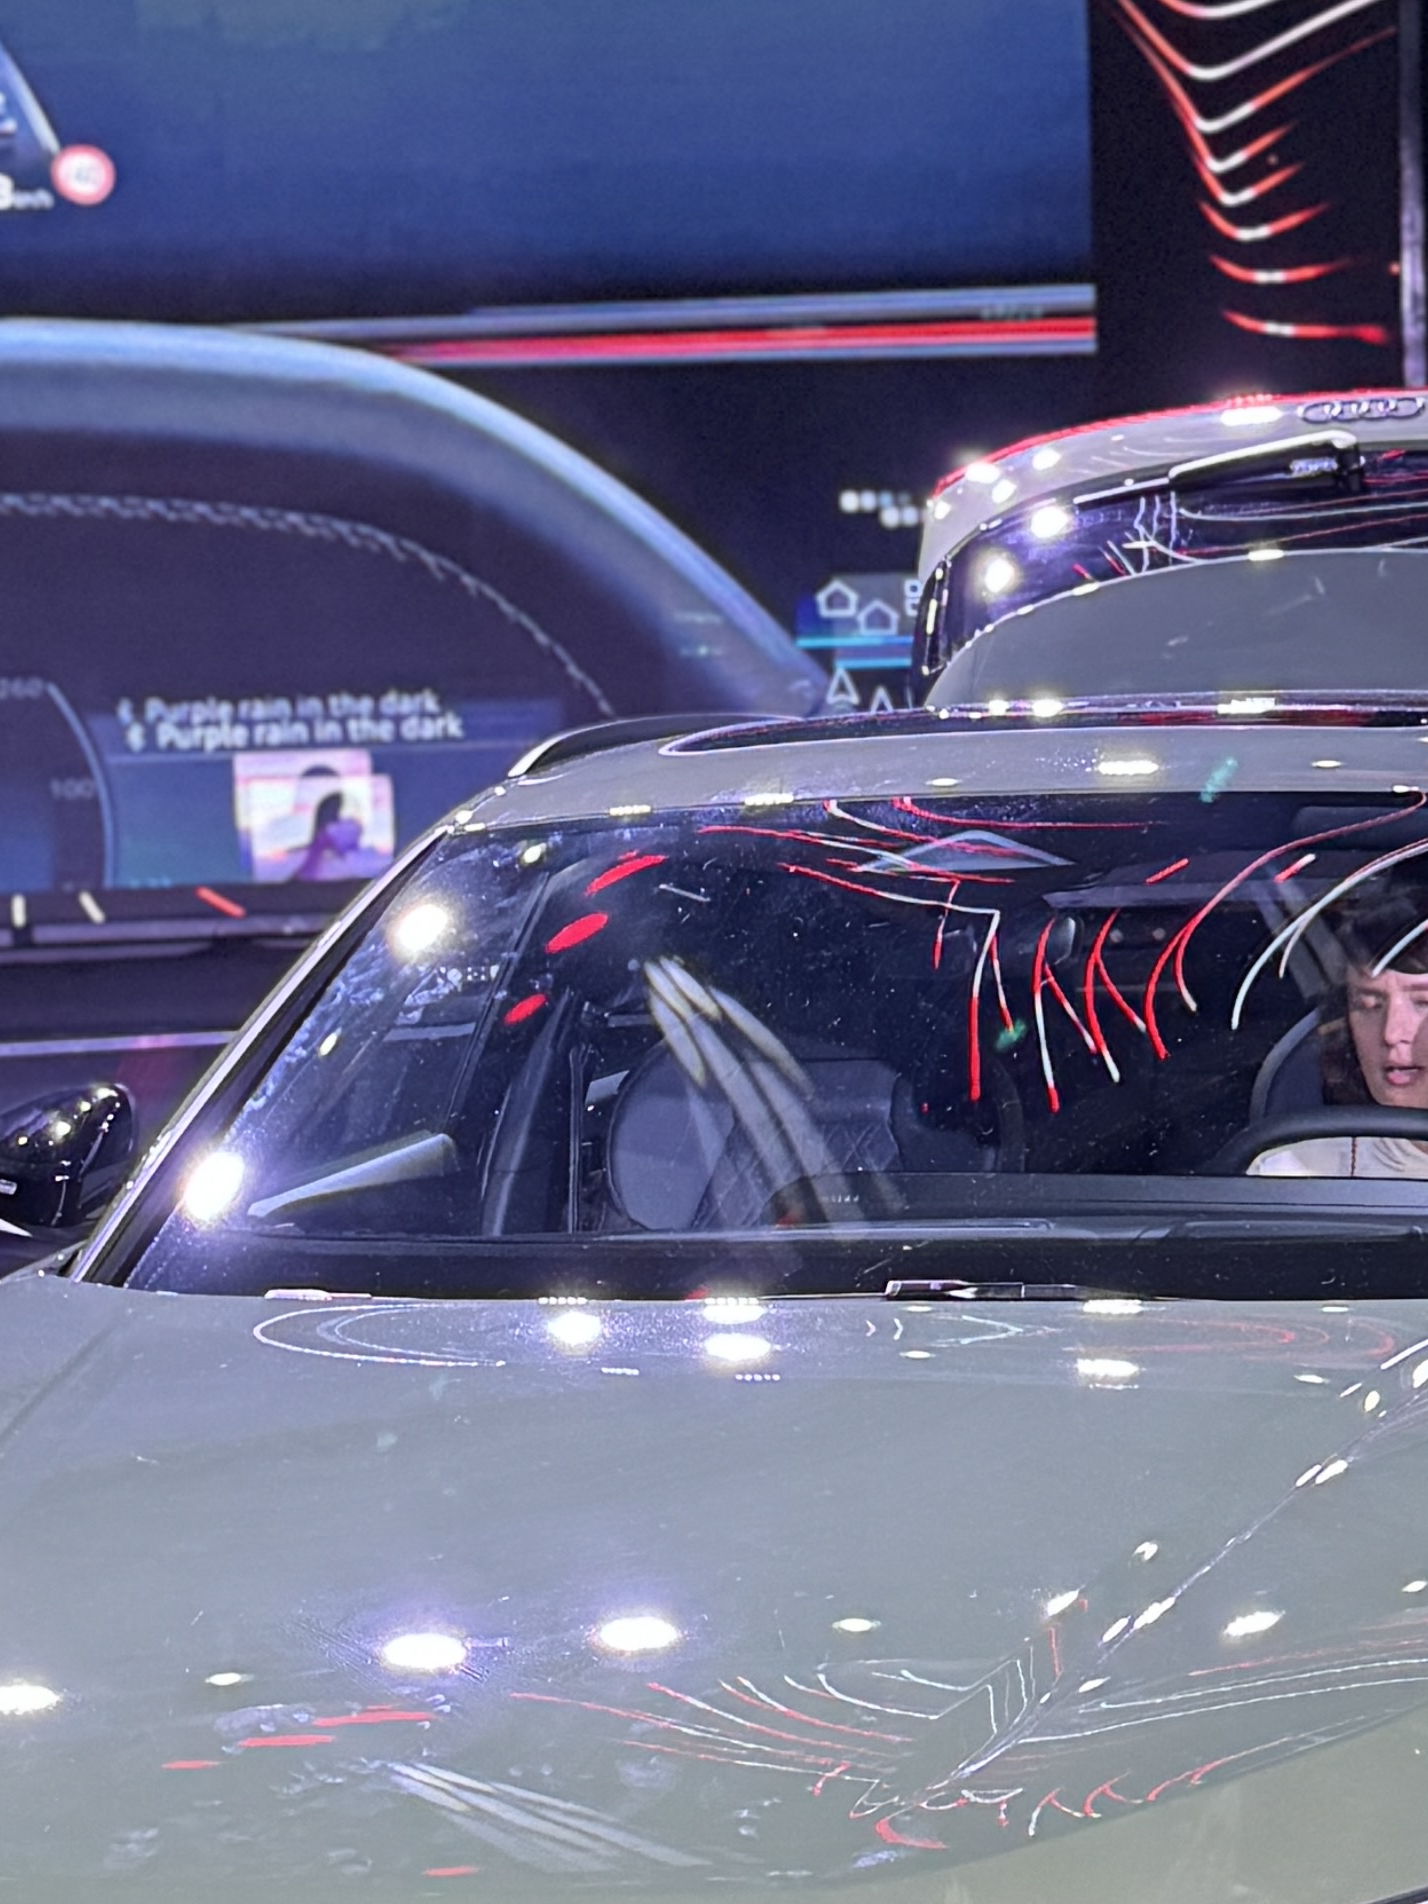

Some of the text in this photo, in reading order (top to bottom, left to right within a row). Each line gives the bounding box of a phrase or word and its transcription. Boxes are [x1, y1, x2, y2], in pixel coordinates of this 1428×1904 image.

[156, 710, 464, 752] Purple rain in the dark
